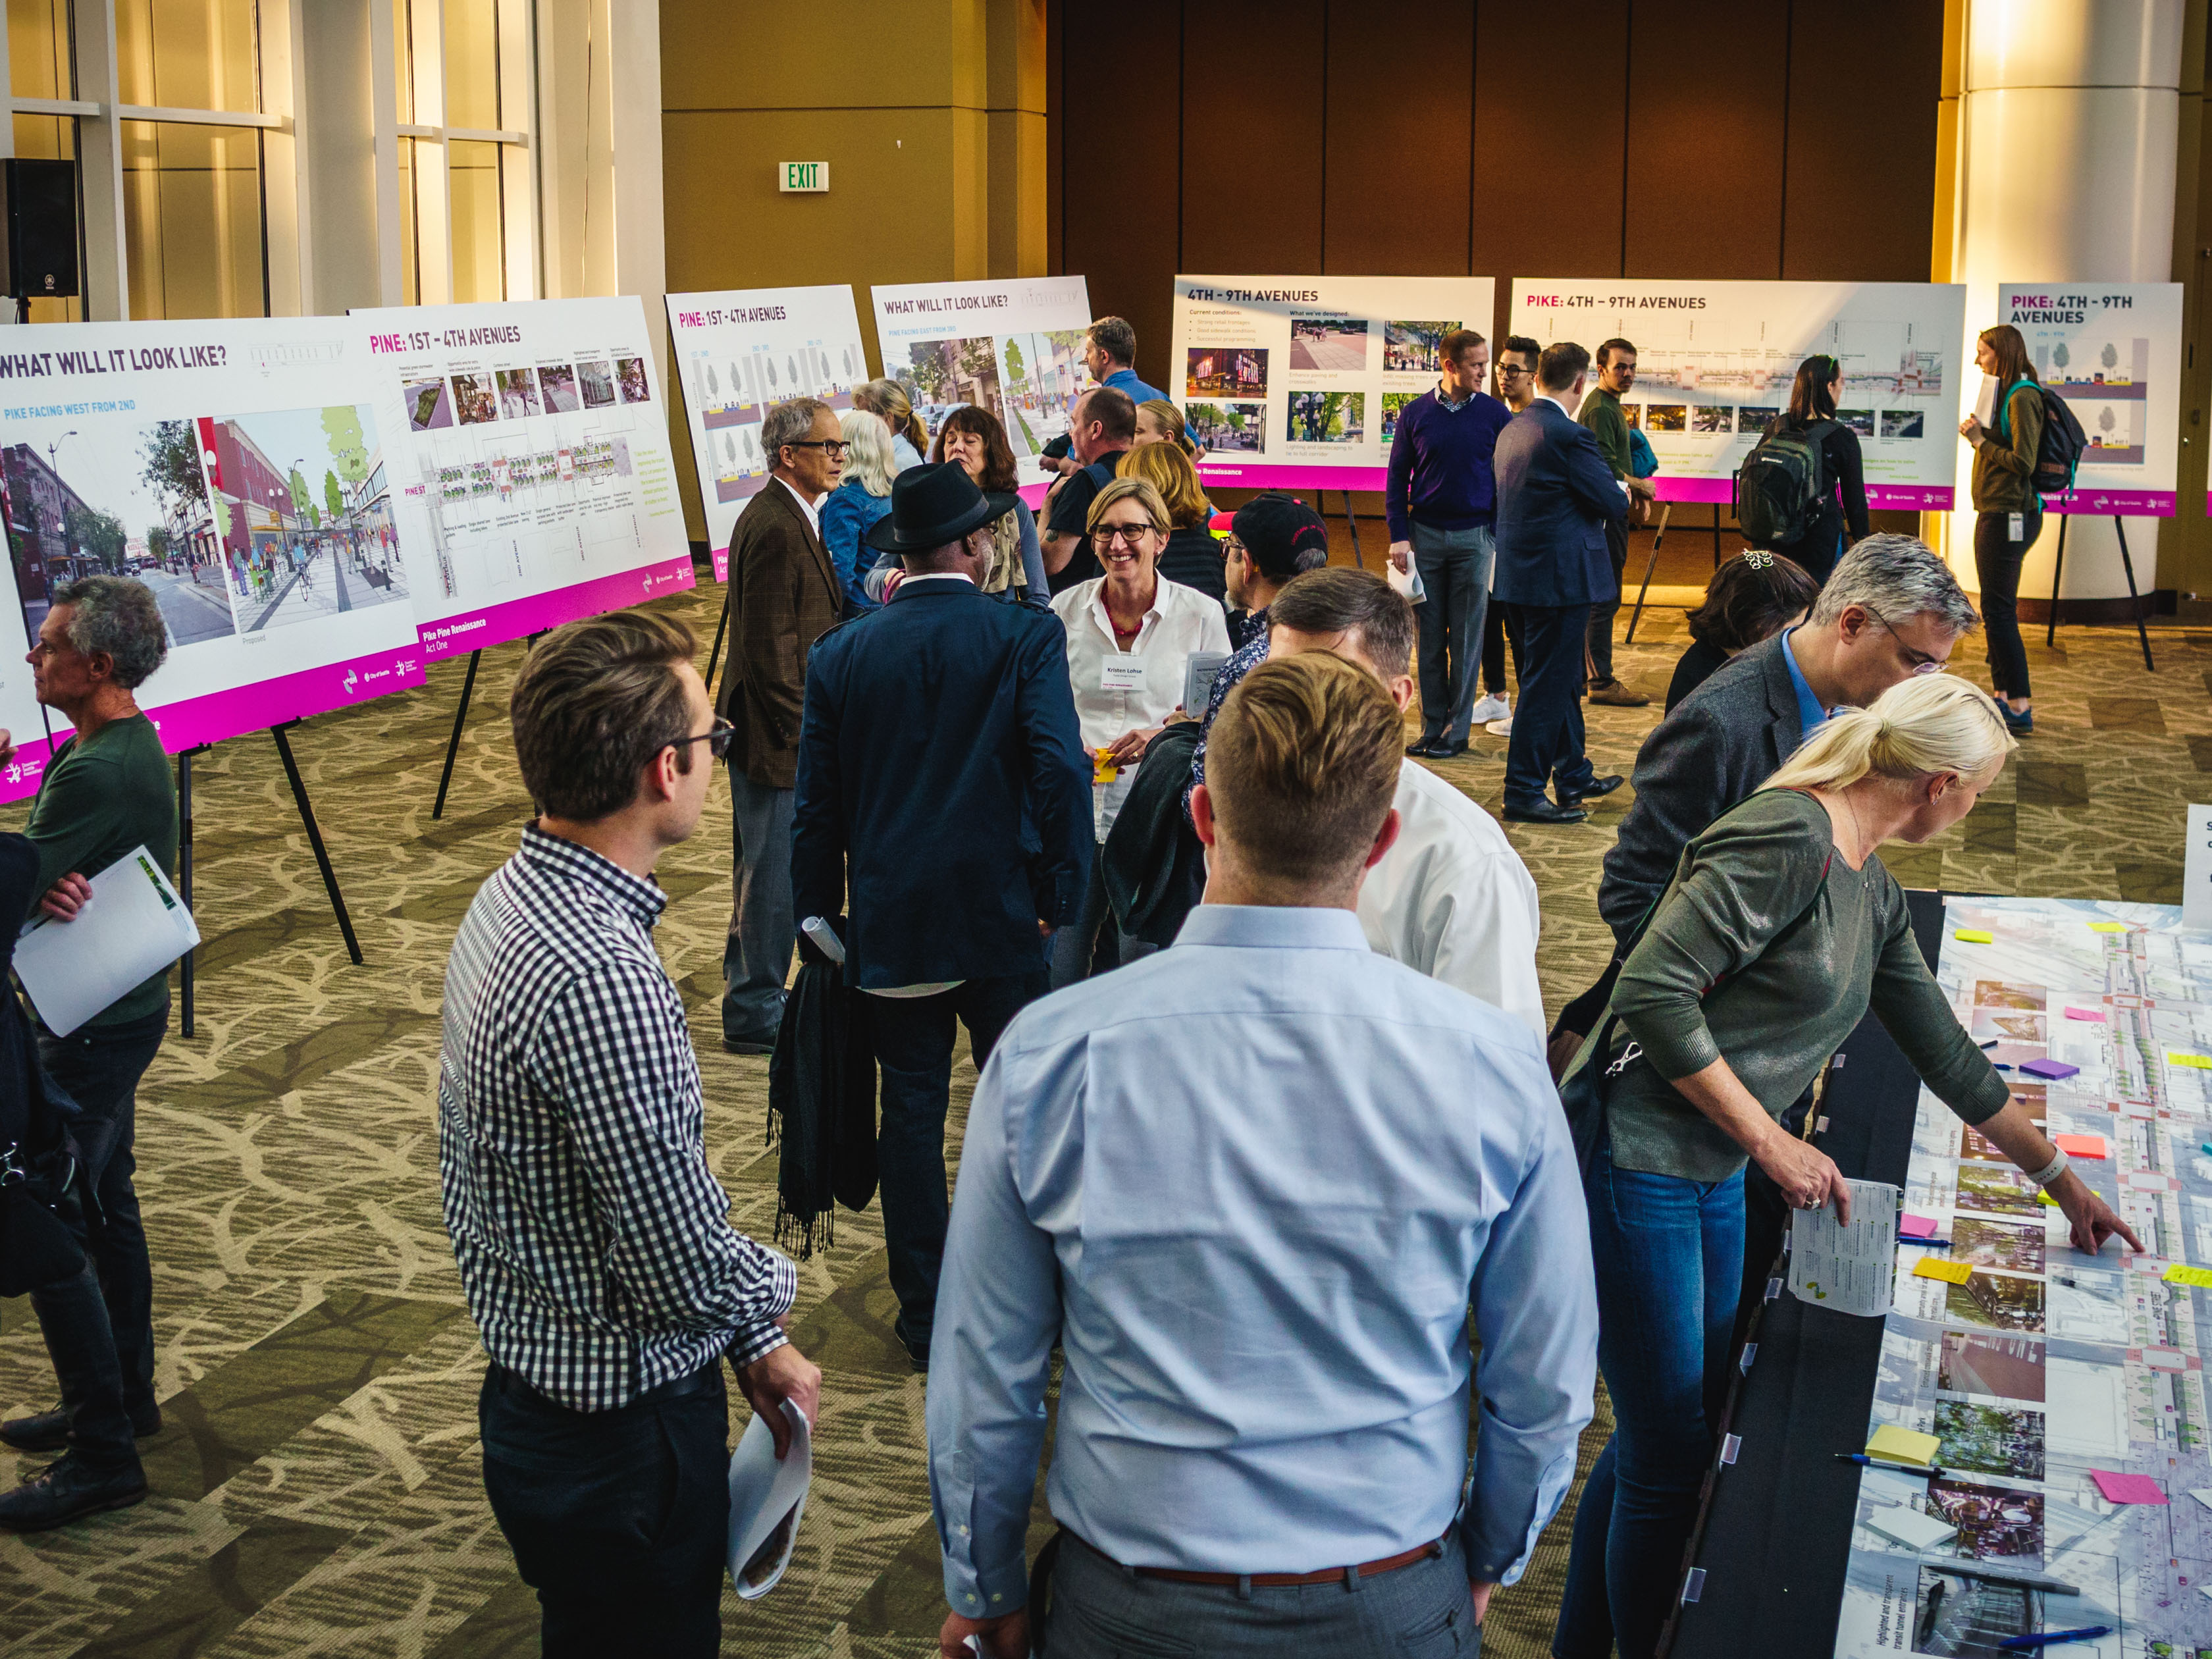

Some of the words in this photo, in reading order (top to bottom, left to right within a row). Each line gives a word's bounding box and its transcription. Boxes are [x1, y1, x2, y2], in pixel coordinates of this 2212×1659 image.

[789, 164, 818, 188] EXIT
[884, 300, 914, 314] WHAT
[916, 298, 942, 312] WILL
[943, 298, 952, 310] IT
[955, 296, 980, 310] LOOK
[983, 294, 1008, 308] LIKE?
[1188, 290, 1213, 300] 4TH
[1226, 290, 1251, 301] 9TH
[1255, 291, 1318, 302] AVENUES
[1527, 296, 1564, 307] PIKE:
[1567, 296, 1594, 307] 4TH
[1609, 296, 1635, 308] 9TH
[1639, 297, 1706, 309] AVENUES
[2011, 296, 2053, 308] PIKE:
[2057, 296, 2088, 308] 4TH
[2103, 296, 2132, 308] 9TH
[679, 311, 705, 328] PINE:
[706, 310, 722, 326] 1ST
[730, 308, 747, 324] 4TH
[749, 306, 786, 322] AVENUES
[2011, 311, 2084, 324] AVENUES
[370, 334, 407, 354] PINE:
[408, 331, 430, 350] 1ST
[444, 329, 467, 348] 4TH
[469, 326, 521, 346] AVENUES
[0, 353, 51, 379] WHAT
[55, 351, 107, 375] WILL
[108, 350, 126, 372] IT
[129, 346, 178, 371] LOOK
[179, 345, 226, 368] LIKE?
[4, 408, 28, 420] PIKE
[29, 405, 63, 418] FACING
[64, 403, 90, 415] WEST
[92, 401, 117, 413] FROM
[118, 400, 136, 411] 2ND
[405, 487, 419, 496] PINE
[419, 485, 426, 494] ST
[423, 630, 436, 642] Pike
[436, 627, 451, 639] Pine
[450, 618, 487, 634] Renaissance
[426, 643, 436, 653] Act
[436, 641, 448, 651] One
[1916, 1417, 1926, 1427] Park
[1883, 1574, 1894, 1604] transparent
[1898, 1587, 1909, 1612] entrances
[1881, 1604, 1891, 1615] and
[1876, 1614, 1890, 1646] Highlighted
[1895, 1613, 1905, 1631] tunnel
[1892, 1631, 1904, 1650] transit
